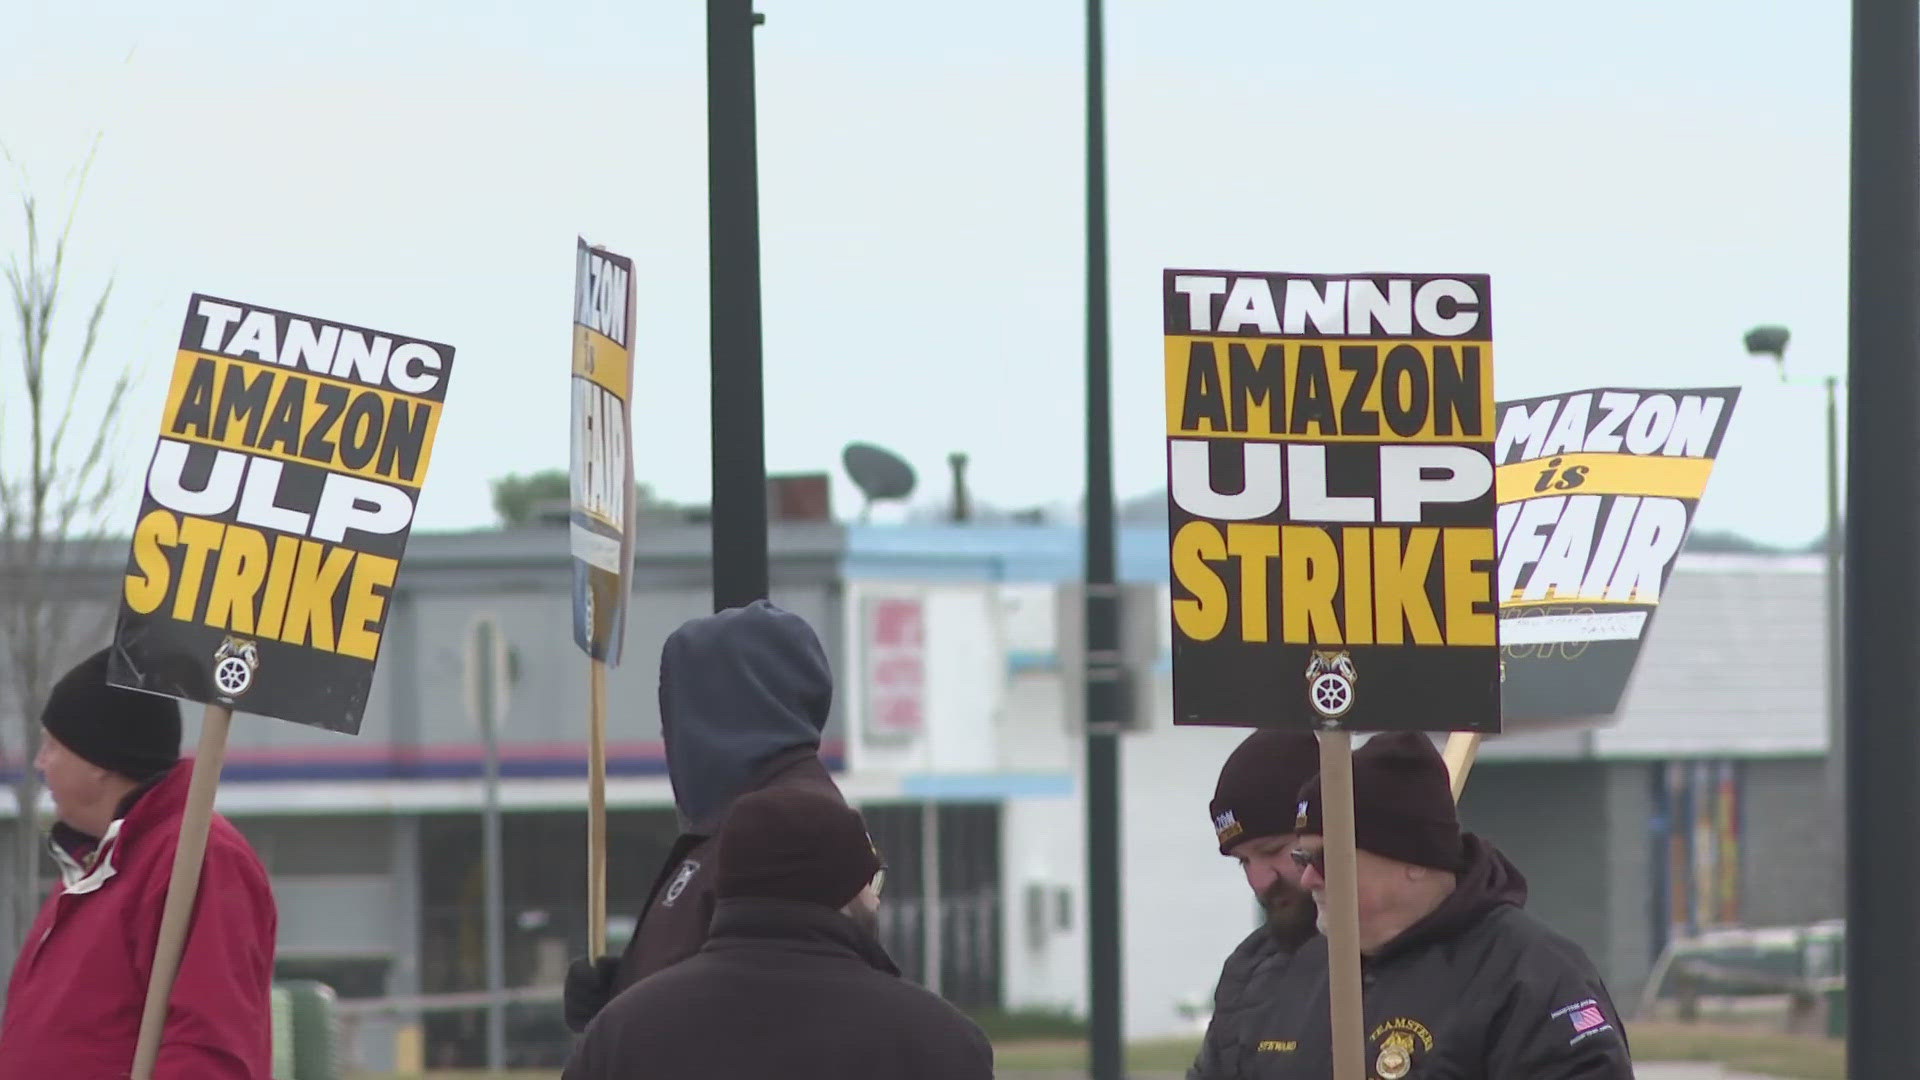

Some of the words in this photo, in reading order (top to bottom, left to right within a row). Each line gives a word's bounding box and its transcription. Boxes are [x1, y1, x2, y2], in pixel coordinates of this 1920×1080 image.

[197, 300, 442, 394] TANNC
[1175, 274, 1479, 336] TANNC
[171, 357, 432, 482] AMAZON
[1180, 341, 1482, 437] AMAZON
[147, 439, 414, 543] ULP
[1171, 439, 1494, 523] ULP
[1534, 457, 1590, 492] is
[124, 509, 399, 661] STRIKE
[1172, 520, 1496, 646] STRIKE
